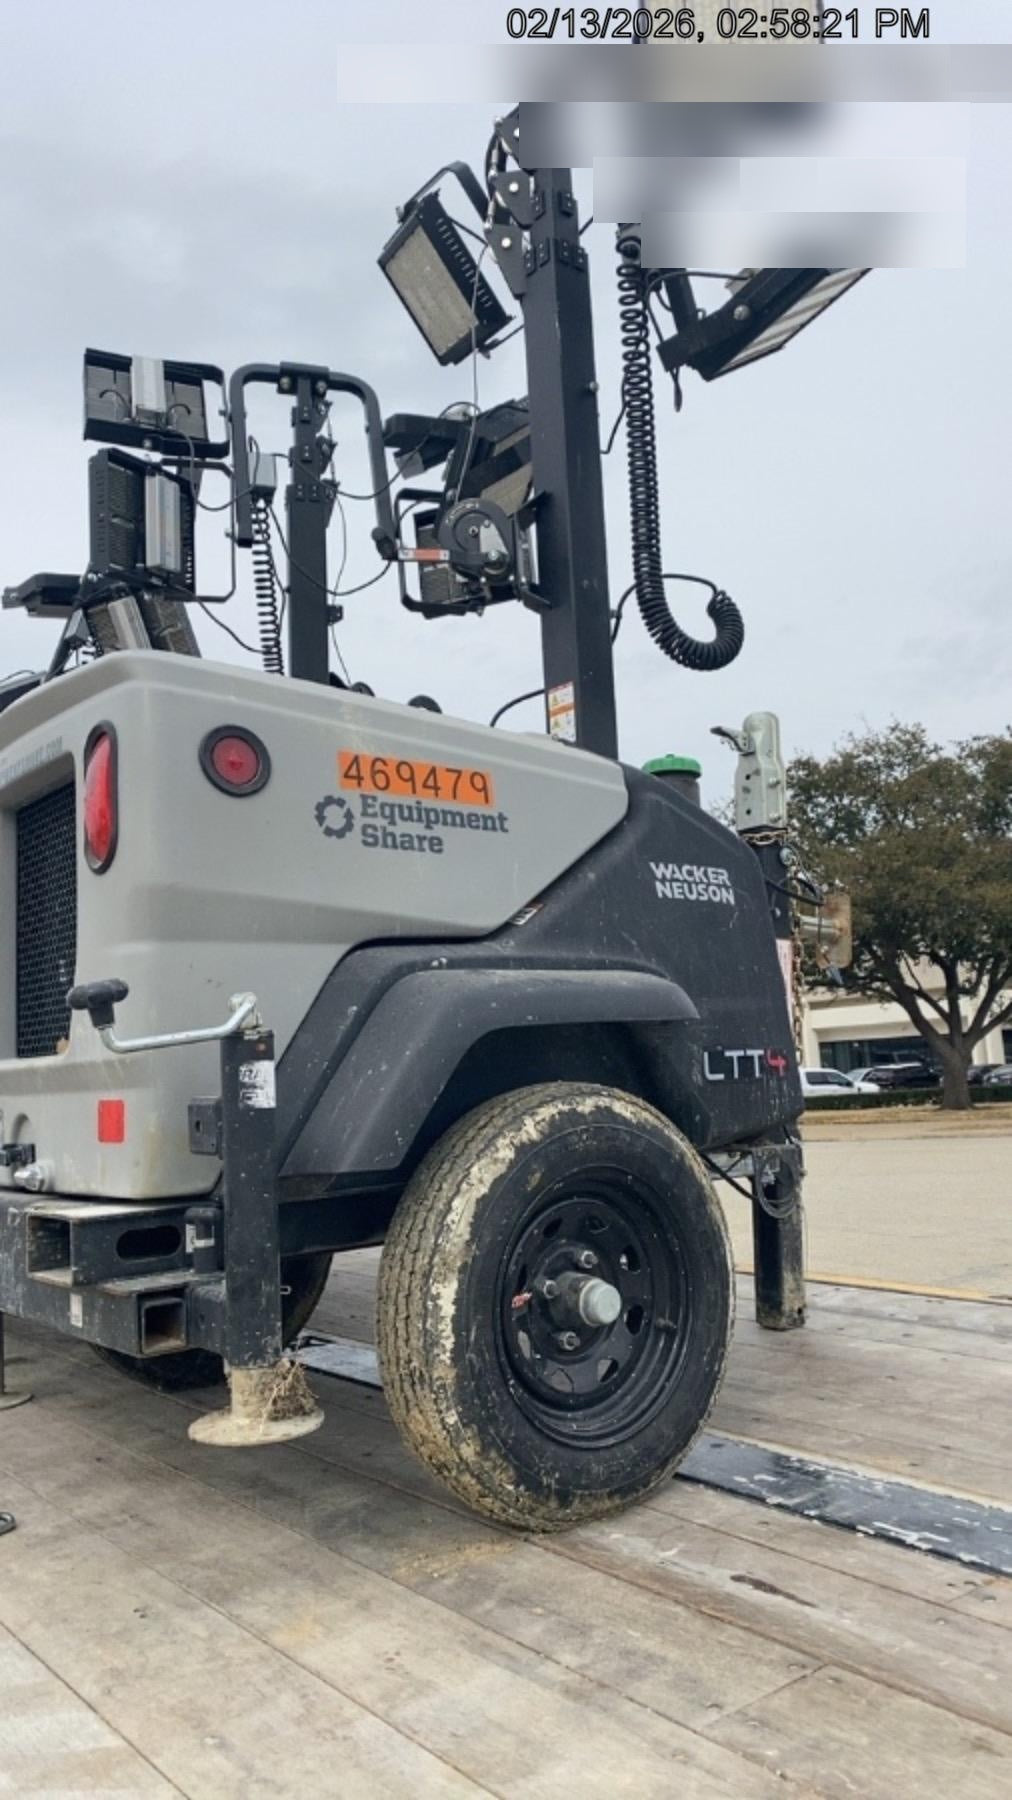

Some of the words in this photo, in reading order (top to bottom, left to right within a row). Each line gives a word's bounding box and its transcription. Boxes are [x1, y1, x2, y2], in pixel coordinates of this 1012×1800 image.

[343, 754, 489, 804] 469479
[360, 793, 509, 833] Equipment
[361, 823, 444, 854] Share
[649, 861, 732, 887] WACKER
[655, 880, 735, 906] NEUSON
[703, 1048, 786, 1081] LTT4
